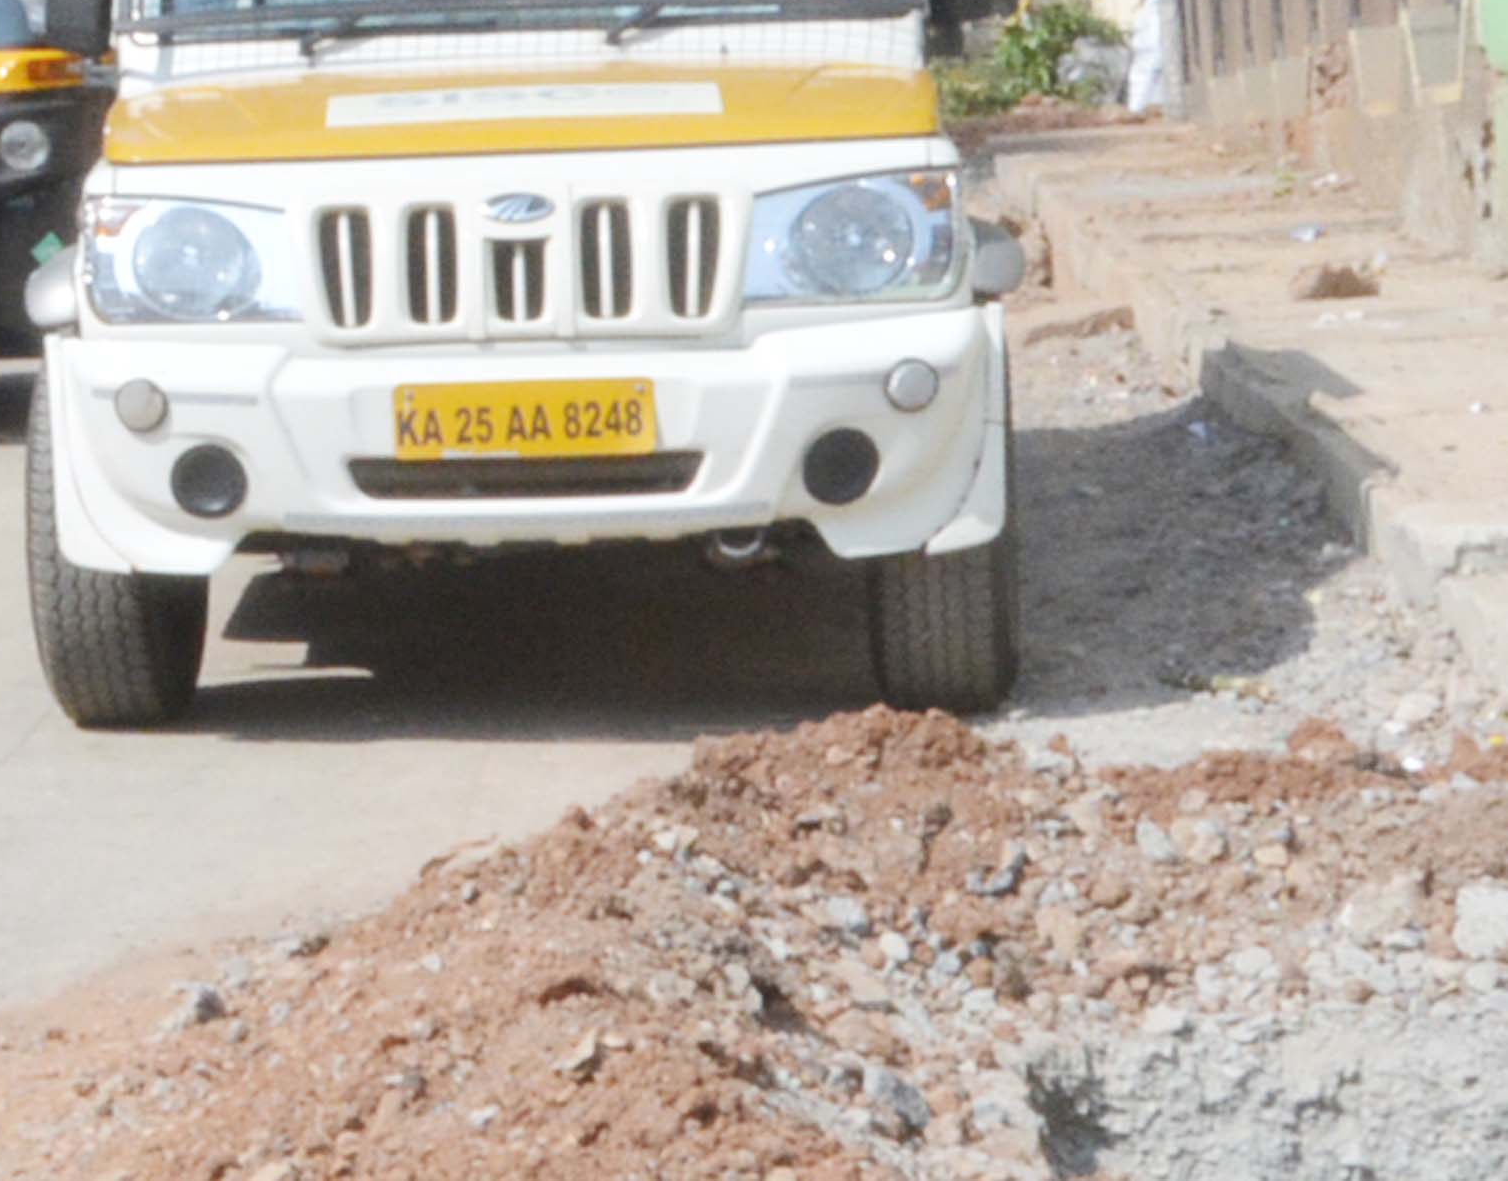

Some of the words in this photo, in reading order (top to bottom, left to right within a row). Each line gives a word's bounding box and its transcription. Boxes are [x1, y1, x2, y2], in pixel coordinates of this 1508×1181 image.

[395, 408, 444, 446] KA
[455, 405, 494, 445] 25
[506, 404, 552, 442] AA
[562, 397, 643, 440] 8248
